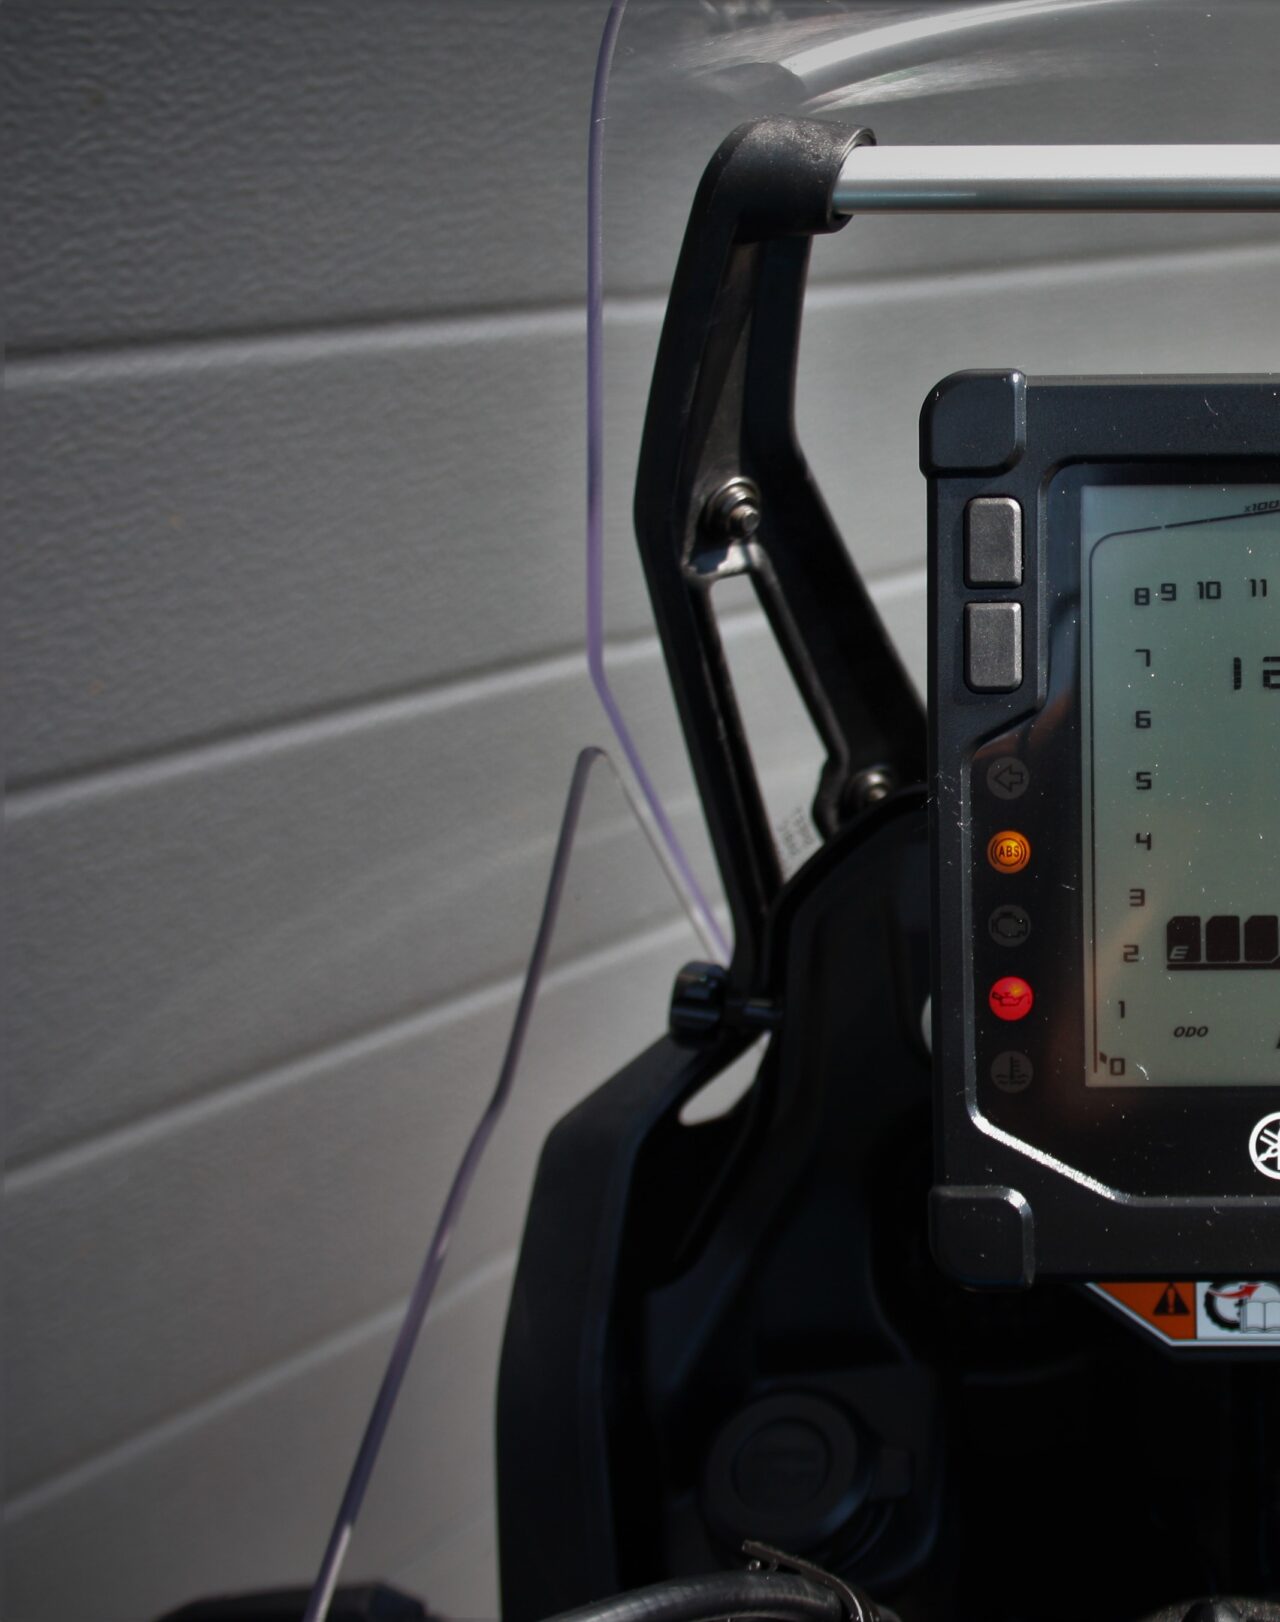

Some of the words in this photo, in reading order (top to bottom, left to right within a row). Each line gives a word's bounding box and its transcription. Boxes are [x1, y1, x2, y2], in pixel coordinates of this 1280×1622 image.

[1134, 587, 1150, 605] 8
[1160, 583, 1177, 601] 9
[1196, 581, 1221, 600] 10
[1249, 578, 1268, 597] 11
[1135, 649, 1151, 667] 7
[1135, 711, 1151, 728] 6
[1136, 772, 1152, 790] 5
[1136, 832, 1152, 850] 4
[998, 845, 1020, 859] ABS
[1129, 888, 1145, 907] 3
[1123, 944, 1139, 962] 2
[1169, 946, 1189, 960] E
[1118, 1001, 1126, 1018] 1
[1173, 1025, 1209, 1038] ODO
[1109, 1058, 1126, 1076] 0
